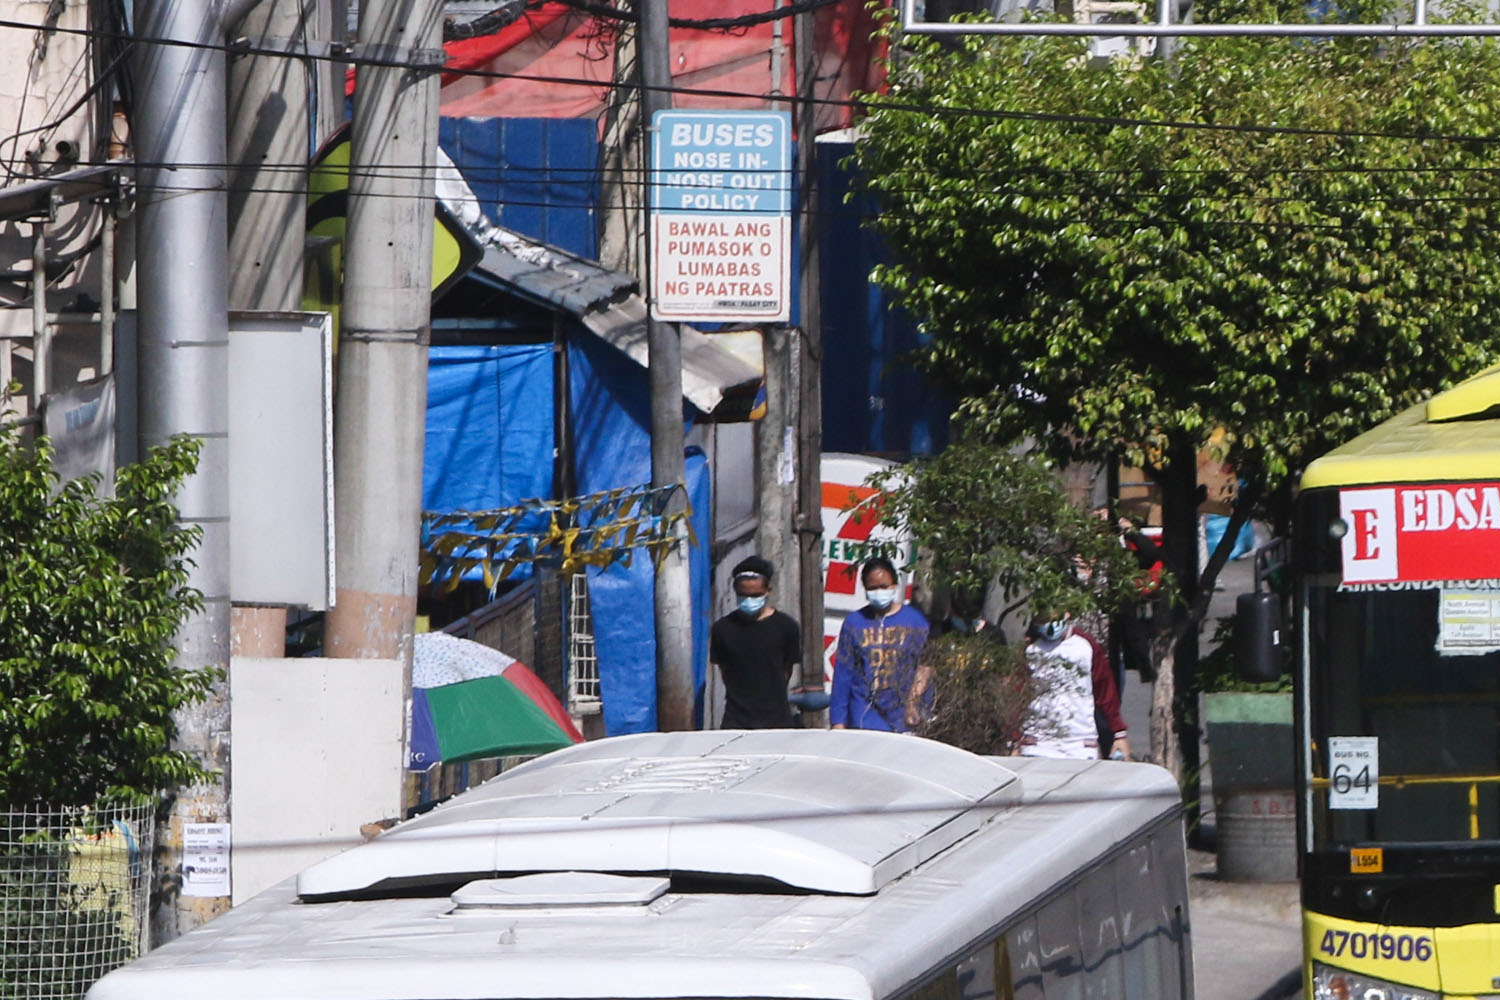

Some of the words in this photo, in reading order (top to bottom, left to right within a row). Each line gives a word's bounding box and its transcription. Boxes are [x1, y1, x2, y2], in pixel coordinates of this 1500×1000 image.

[671, 123, 774, 147] BUSES
[674, 152, 732, 168] NOSE
[666, 173, 724, 189] NOSE
[730, 174, 776, 189] OUT
[681, 194, 760, 211] POLICY
[669, 222, 729, 237] BAWAL
[734, 222, 772, 237] ANG
[668, 241, 753, 257] PUMASOK
[760, 242, 772, 257] O
[678, 261, 761, 277] LUMABAS
[665, 281, 690, 296] NG
[695, 281, 774, 297] PAATRAS
[1351, 509, 1381, 561] E
[1333, 763, 1372, 794] 64
[1320, 929, 1433, 962] 4701906
